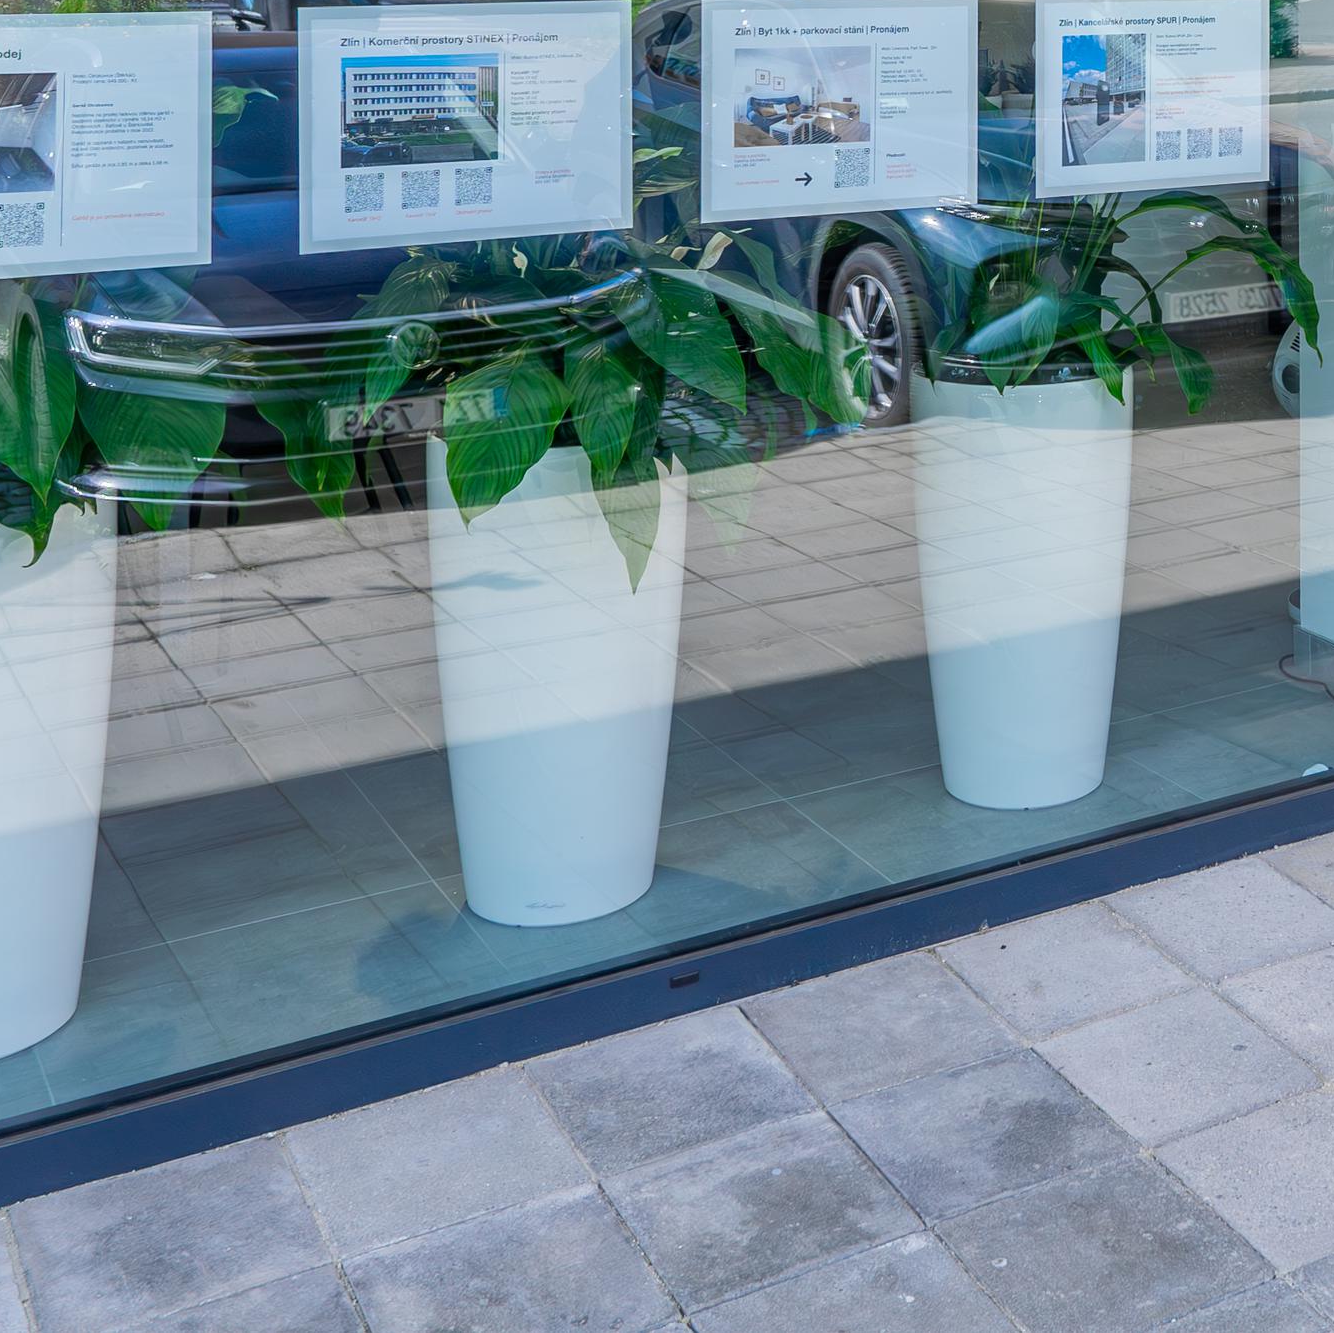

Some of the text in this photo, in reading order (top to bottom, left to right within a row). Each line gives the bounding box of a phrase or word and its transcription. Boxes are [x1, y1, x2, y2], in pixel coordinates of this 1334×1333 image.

[1059, 19, 1073, 27] Zlín
[1078, 17, 1124, 26] Kancelářské
[1126, 17, 1155, 26] prostory
[1182, 16, 1216, 24] Pronájem
[735, 26, 751, 36] Zlín
[758, 27, 773, 36] Byt
[776, 26, 790, 35] 1kk
[800, 25, 843, 36] parkovací
[844, 25, 864, 34] stání
[870, 25, 910, 35] Pronájem
[340, 36, 360, 47] Zlín
[369, 35, 419, 46] Komerční
[422, 36, 464, 47] prostory
[467, 34, 504, 44] STINEX
[512, 32, 558, 43] Pronájem
